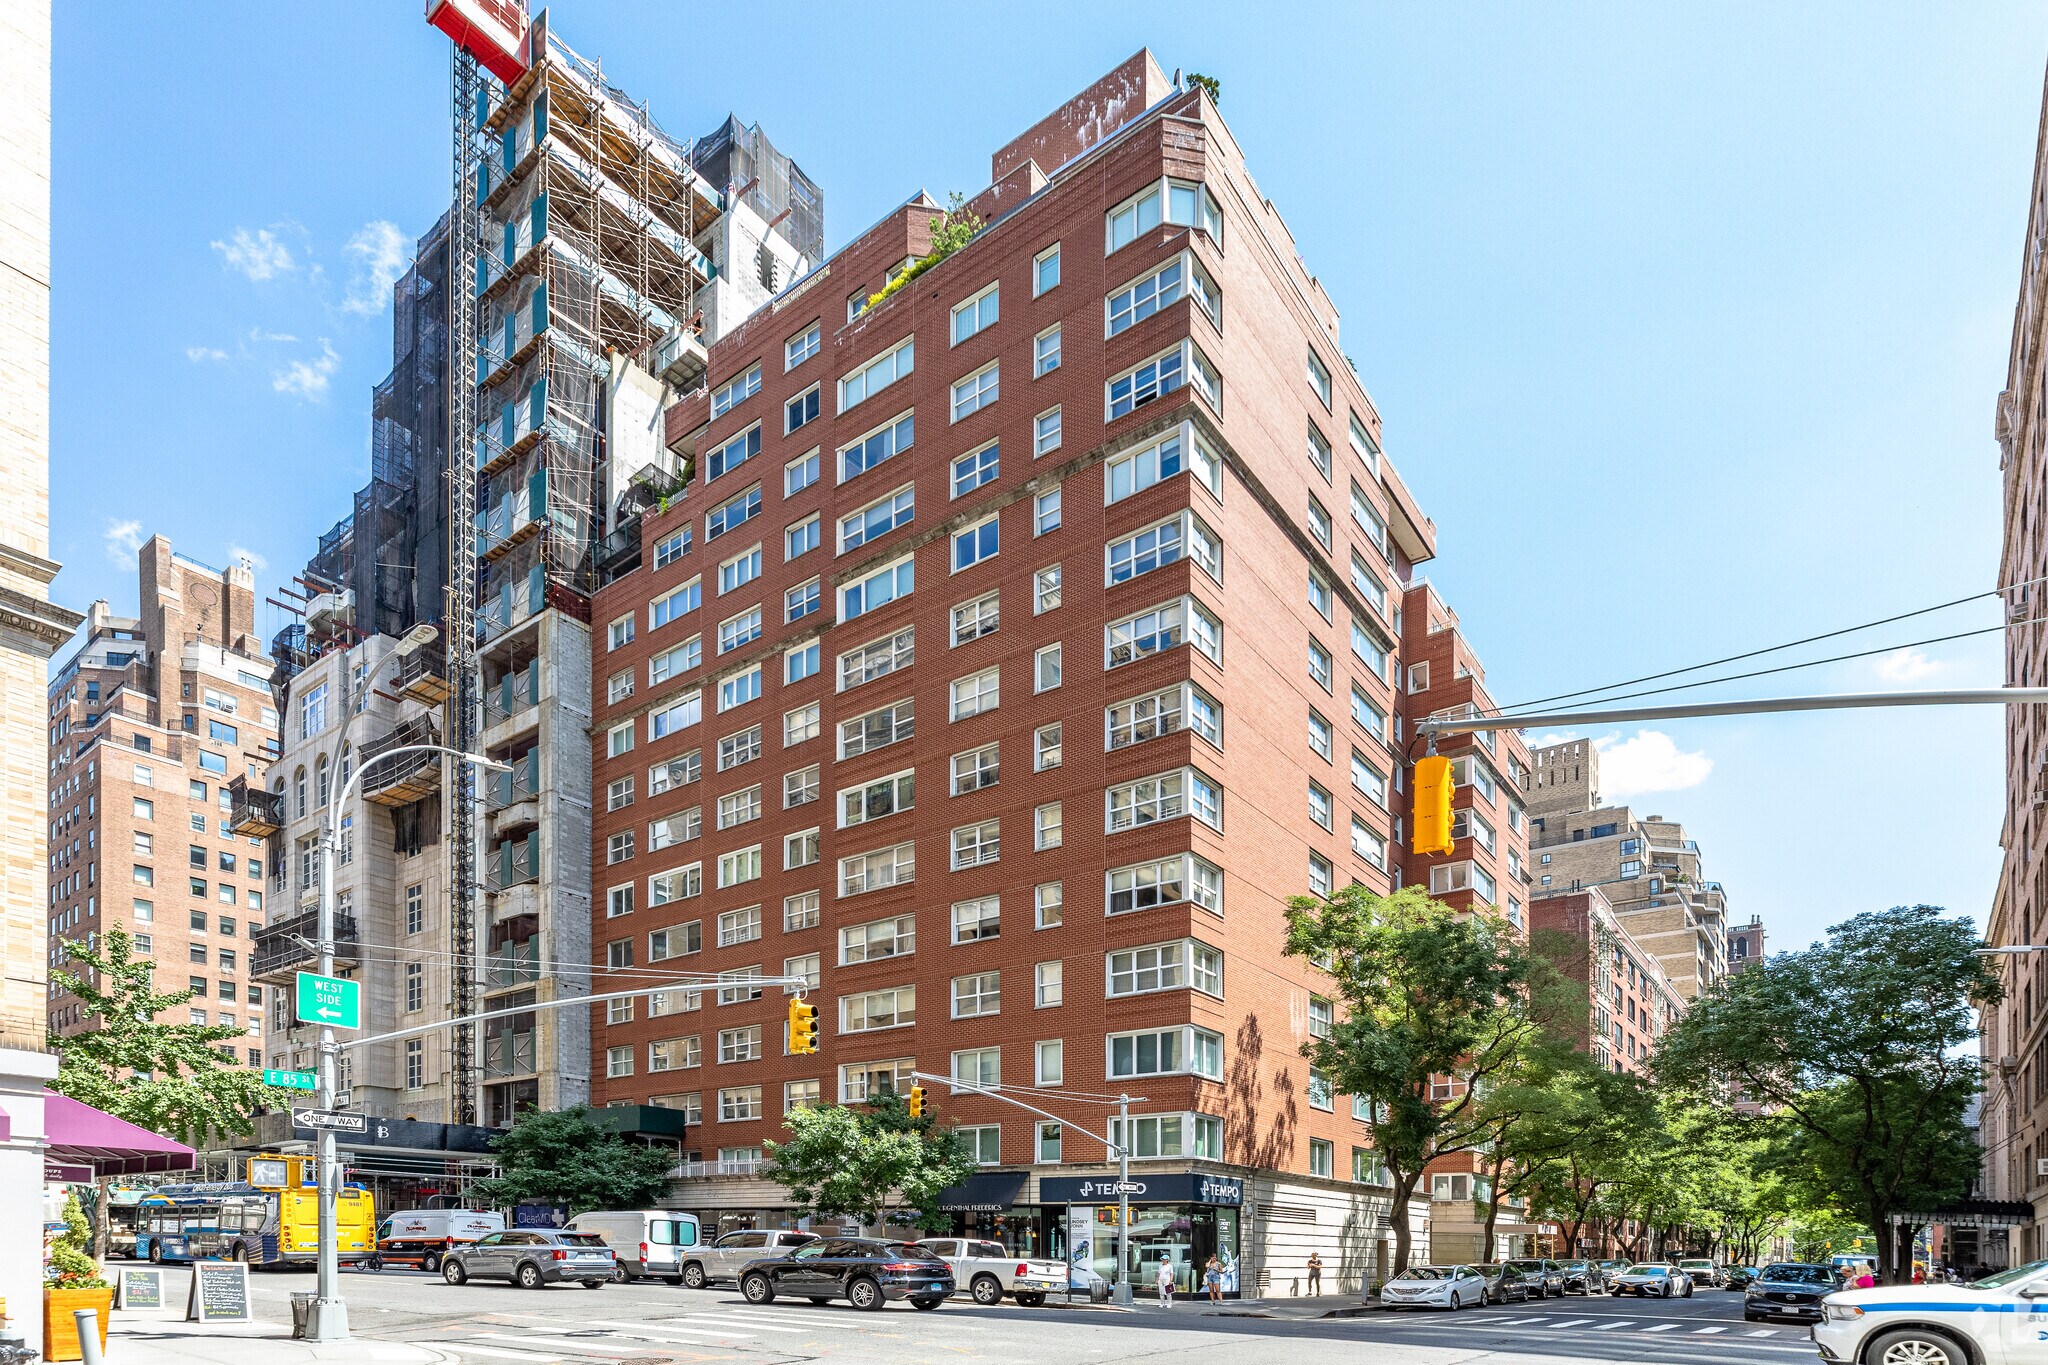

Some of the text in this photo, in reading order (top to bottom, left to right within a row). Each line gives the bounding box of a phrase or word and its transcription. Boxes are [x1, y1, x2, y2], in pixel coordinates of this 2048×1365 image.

[314, 980, 344, 994] WEST
[316, 993, 342, 1006] SIDE
[270, 1072, 277, 1083] E
[282, 1073, 298, 1086] 85
[303, 1114, 360, 1127] ONE WAY
[1095, 1182, 1147, 1195] TEMO
[1209, 1183, 1239, 1198] TEMPO
[518, 1212, 551, 1224] ClearMD
